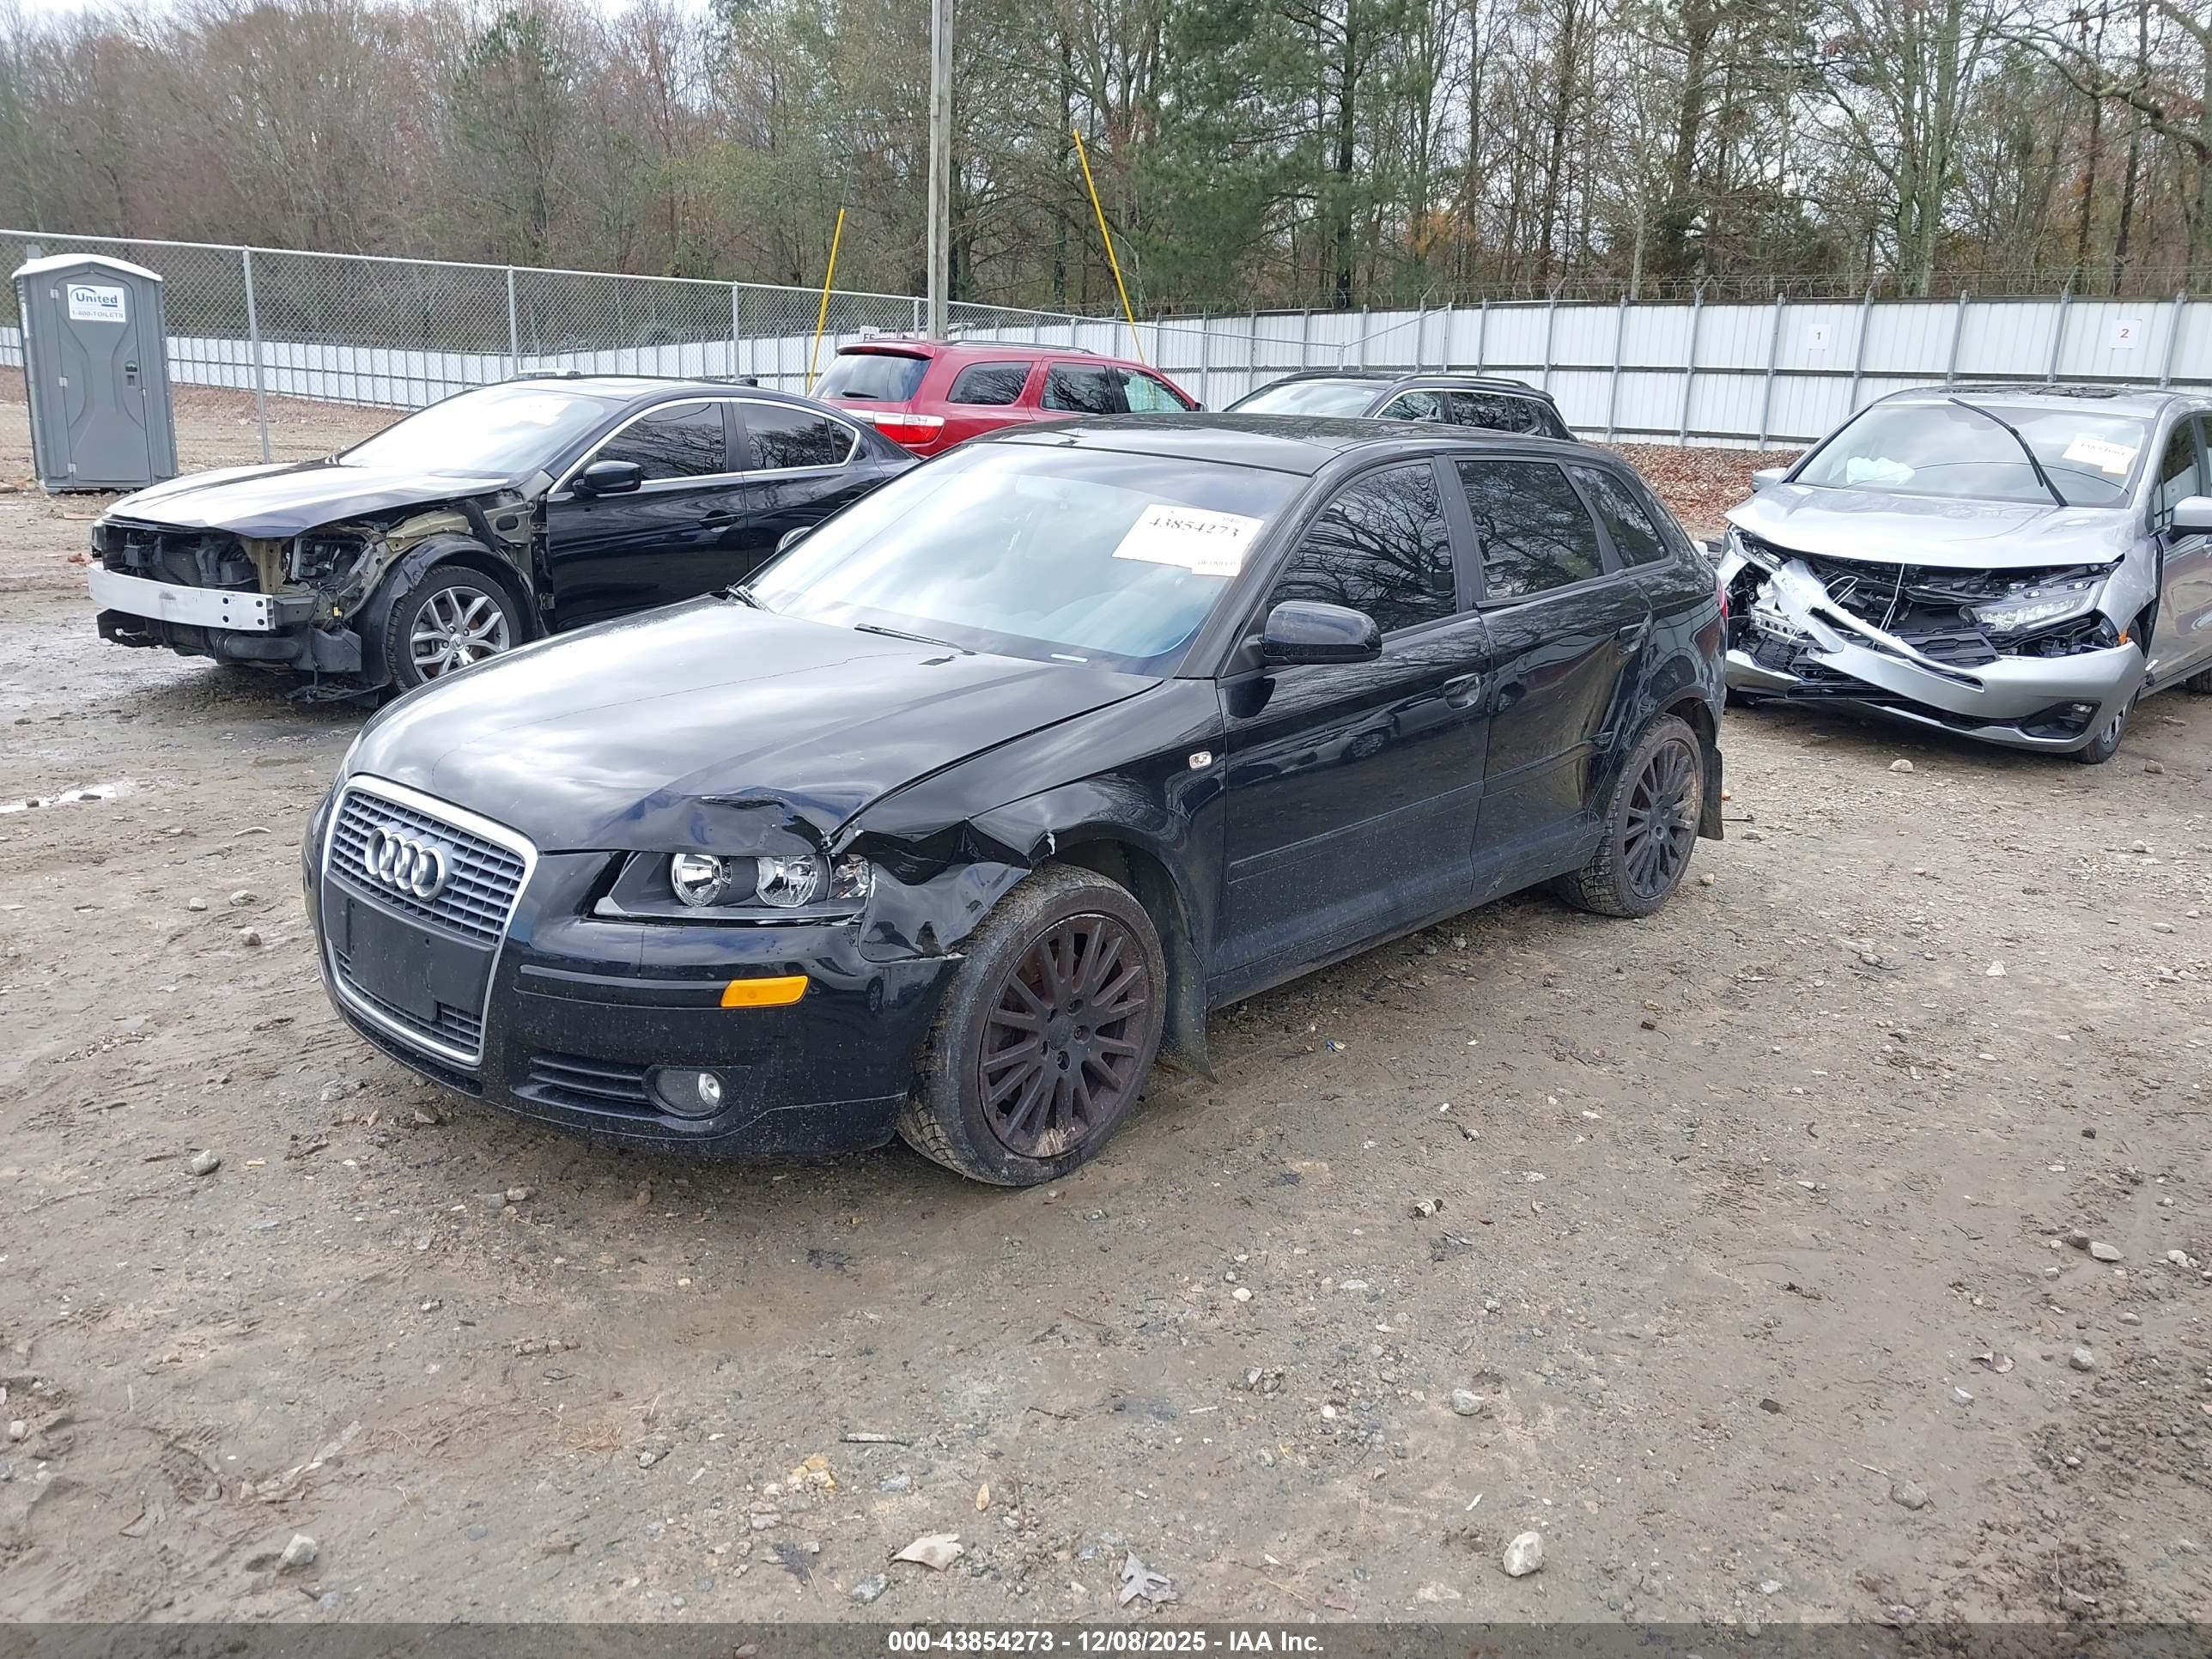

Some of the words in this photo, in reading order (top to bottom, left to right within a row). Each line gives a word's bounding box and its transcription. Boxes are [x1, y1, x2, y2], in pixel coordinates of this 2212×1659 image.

[76, 292, 118, 304] United
[2120, 328, 2130, 338] 2
[1149, 517, 1240, 538] 43854273
